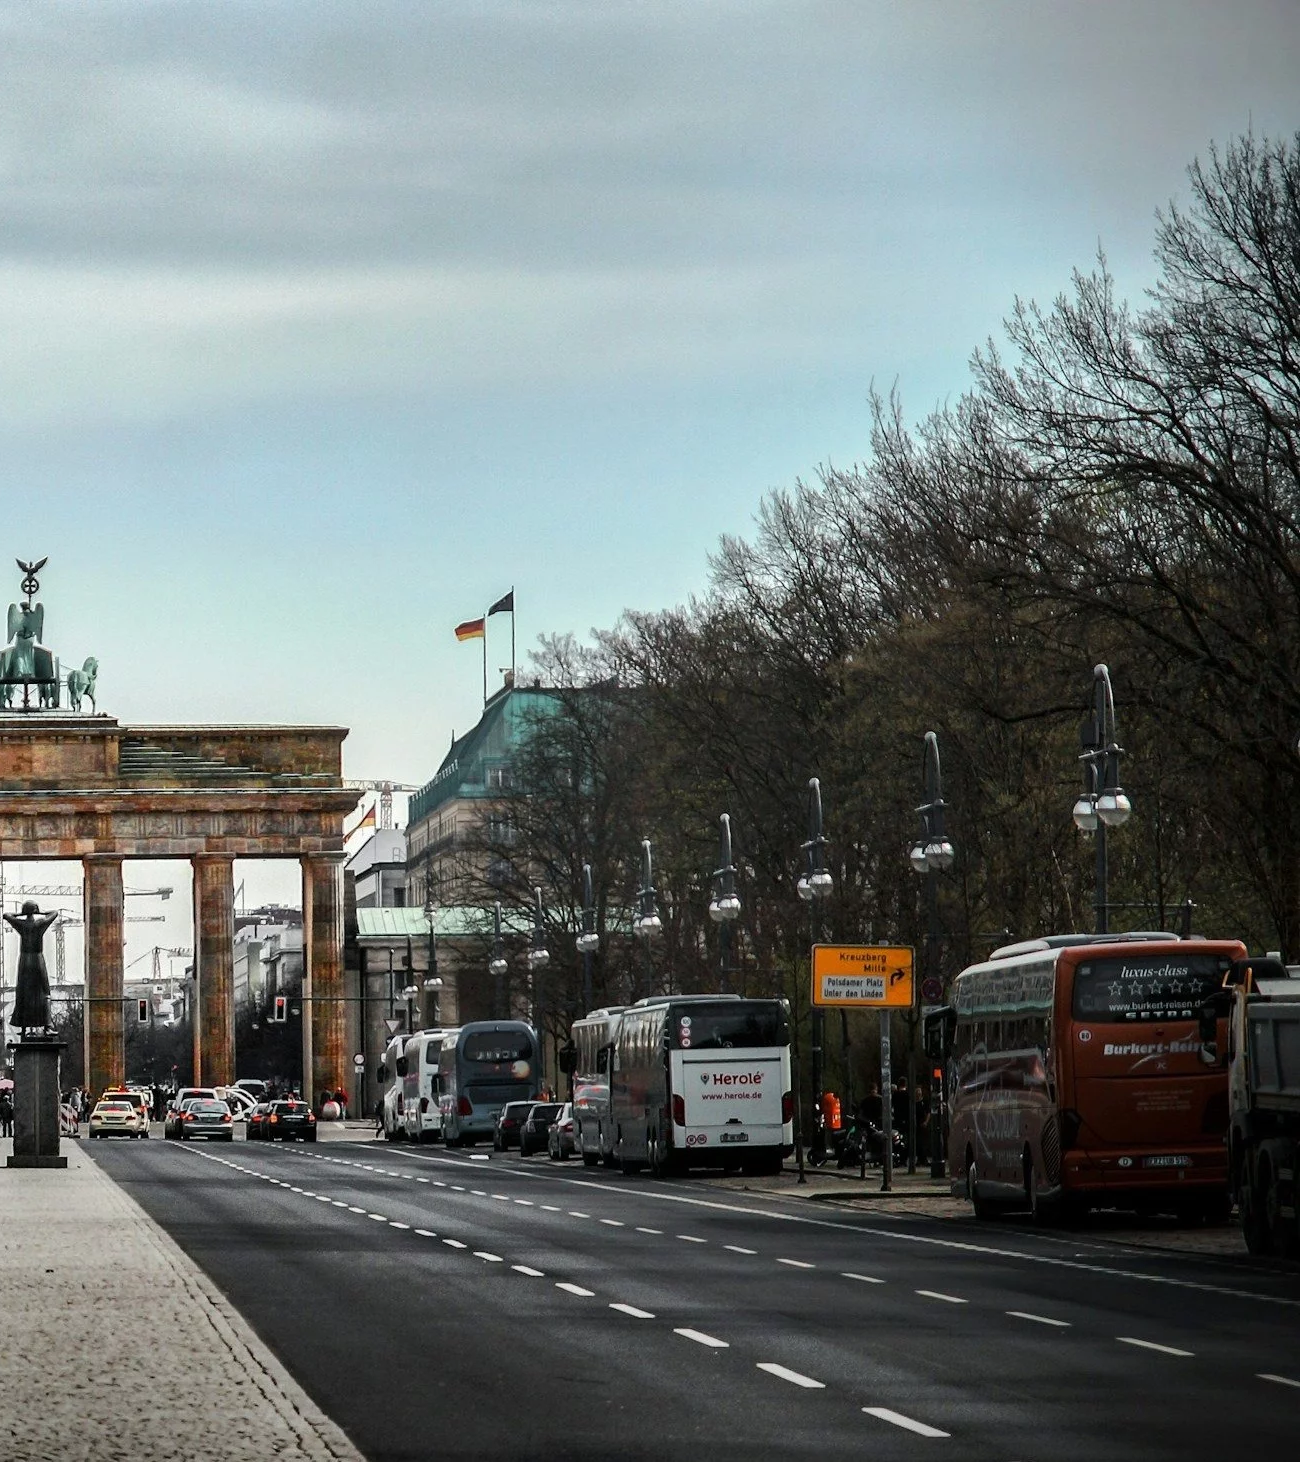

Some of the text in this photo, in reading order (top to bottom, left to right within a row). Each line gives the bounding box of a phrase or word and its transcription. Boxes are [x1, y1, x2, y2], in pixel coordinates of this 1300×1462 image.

[840, 953, 886, 963] Kreuzberg
[1121, 964, 1189, 979] luxus-class
[828, 978, 863, 986] Potsdamer
[824, 989, 883, 997] Unter den Linden
[713, 1072, 762, 1085] Herolé
[702, 1092, 762, 1100] www.herole.de
